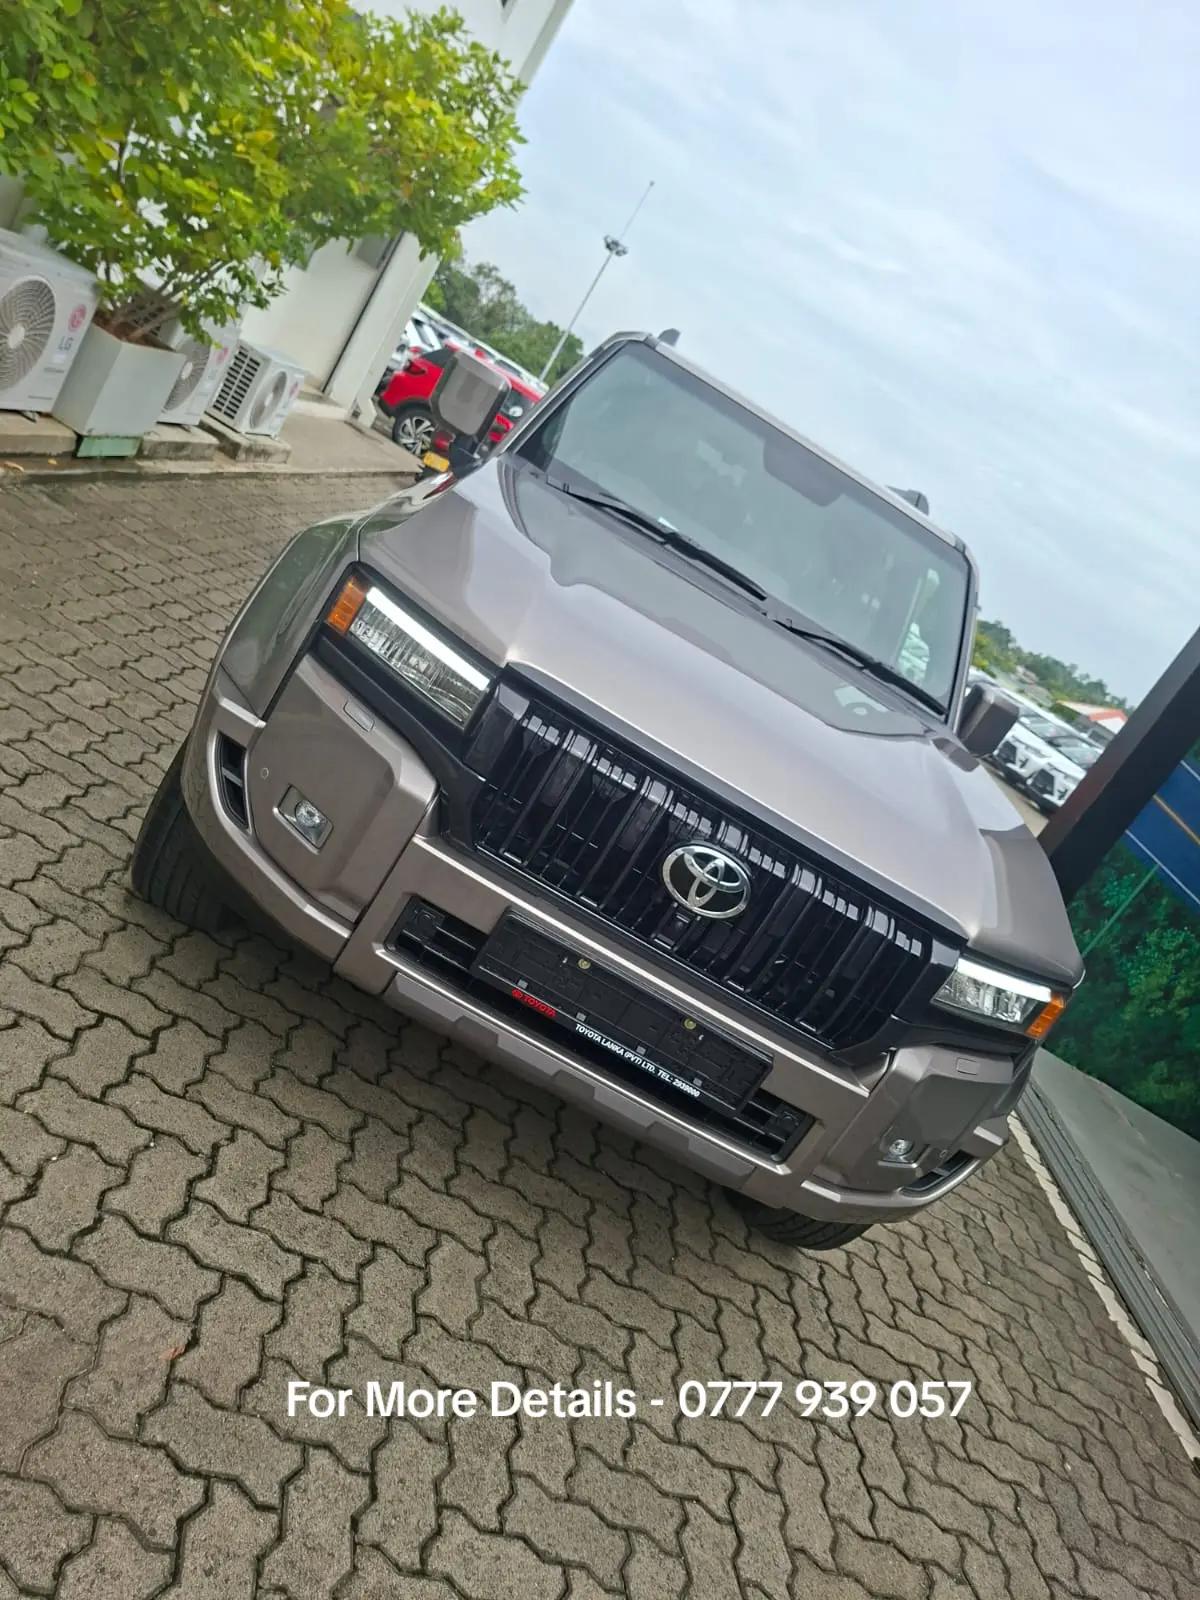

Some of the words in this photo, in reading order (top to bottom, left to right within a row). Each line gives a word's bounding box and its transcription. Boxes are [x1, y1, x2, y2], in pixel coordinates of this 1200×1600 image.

[522, 994, 557, 1018] TOYOTA
[575, 1023, 602, 1043] TOYOTA
[600, 1038, 625, 1056] LANKA
[641, 1061, 656, 1074] LTD.
